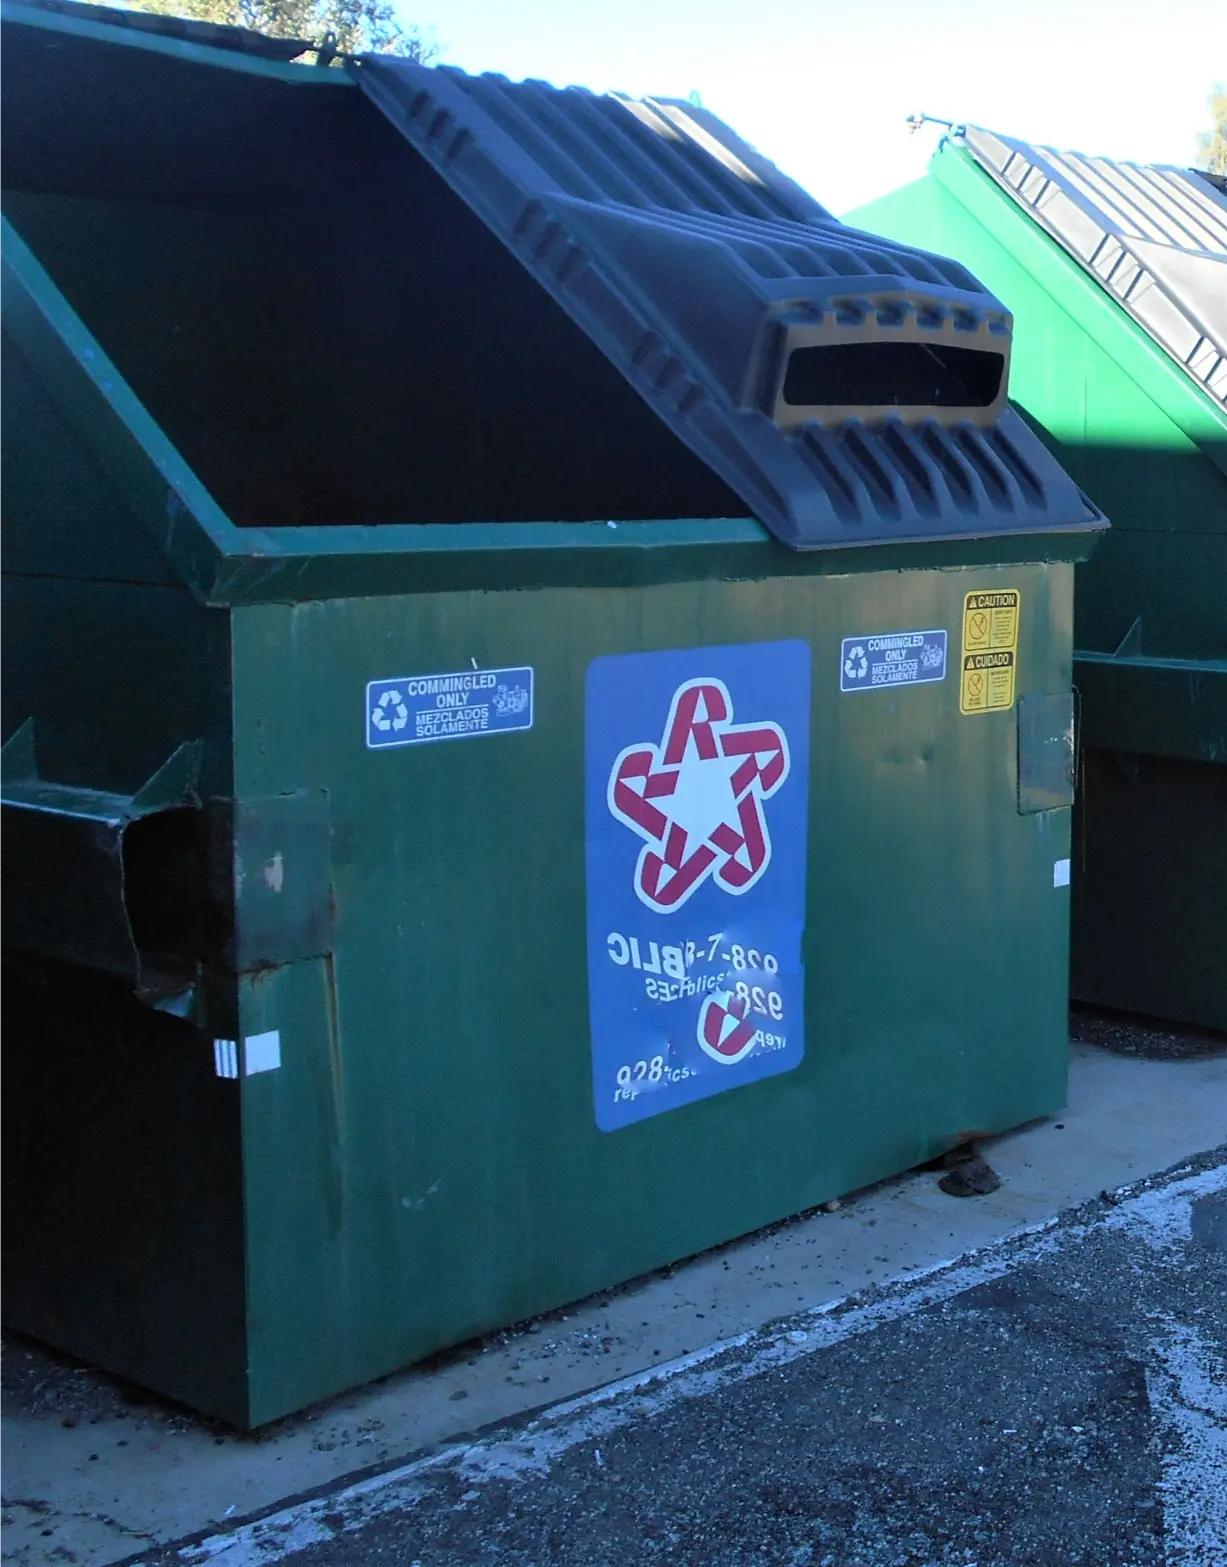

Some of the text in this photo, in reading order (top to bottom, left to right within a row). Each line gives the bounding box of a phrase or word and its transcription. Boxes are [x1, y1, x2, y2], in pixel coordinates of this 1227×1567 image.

[978, 594, 1015, 608] CAUTION
[868, 635, 924, 652] COMMINGLED
[885, 649, 907, 662] ONLY
[975, 653, 1009, 669] CUIDADO
[872, 662, 919, 675] MEZCLADOS
[408, 674, 497, 696] COMMINGLED
[872, 671, 918, 684] SOLAMENTE
[436, 692, 470, 709] ONLY
[415, 707, 489, 726] MEZCLADOS
[416, 719, 489, 737] SOLAMENTE
